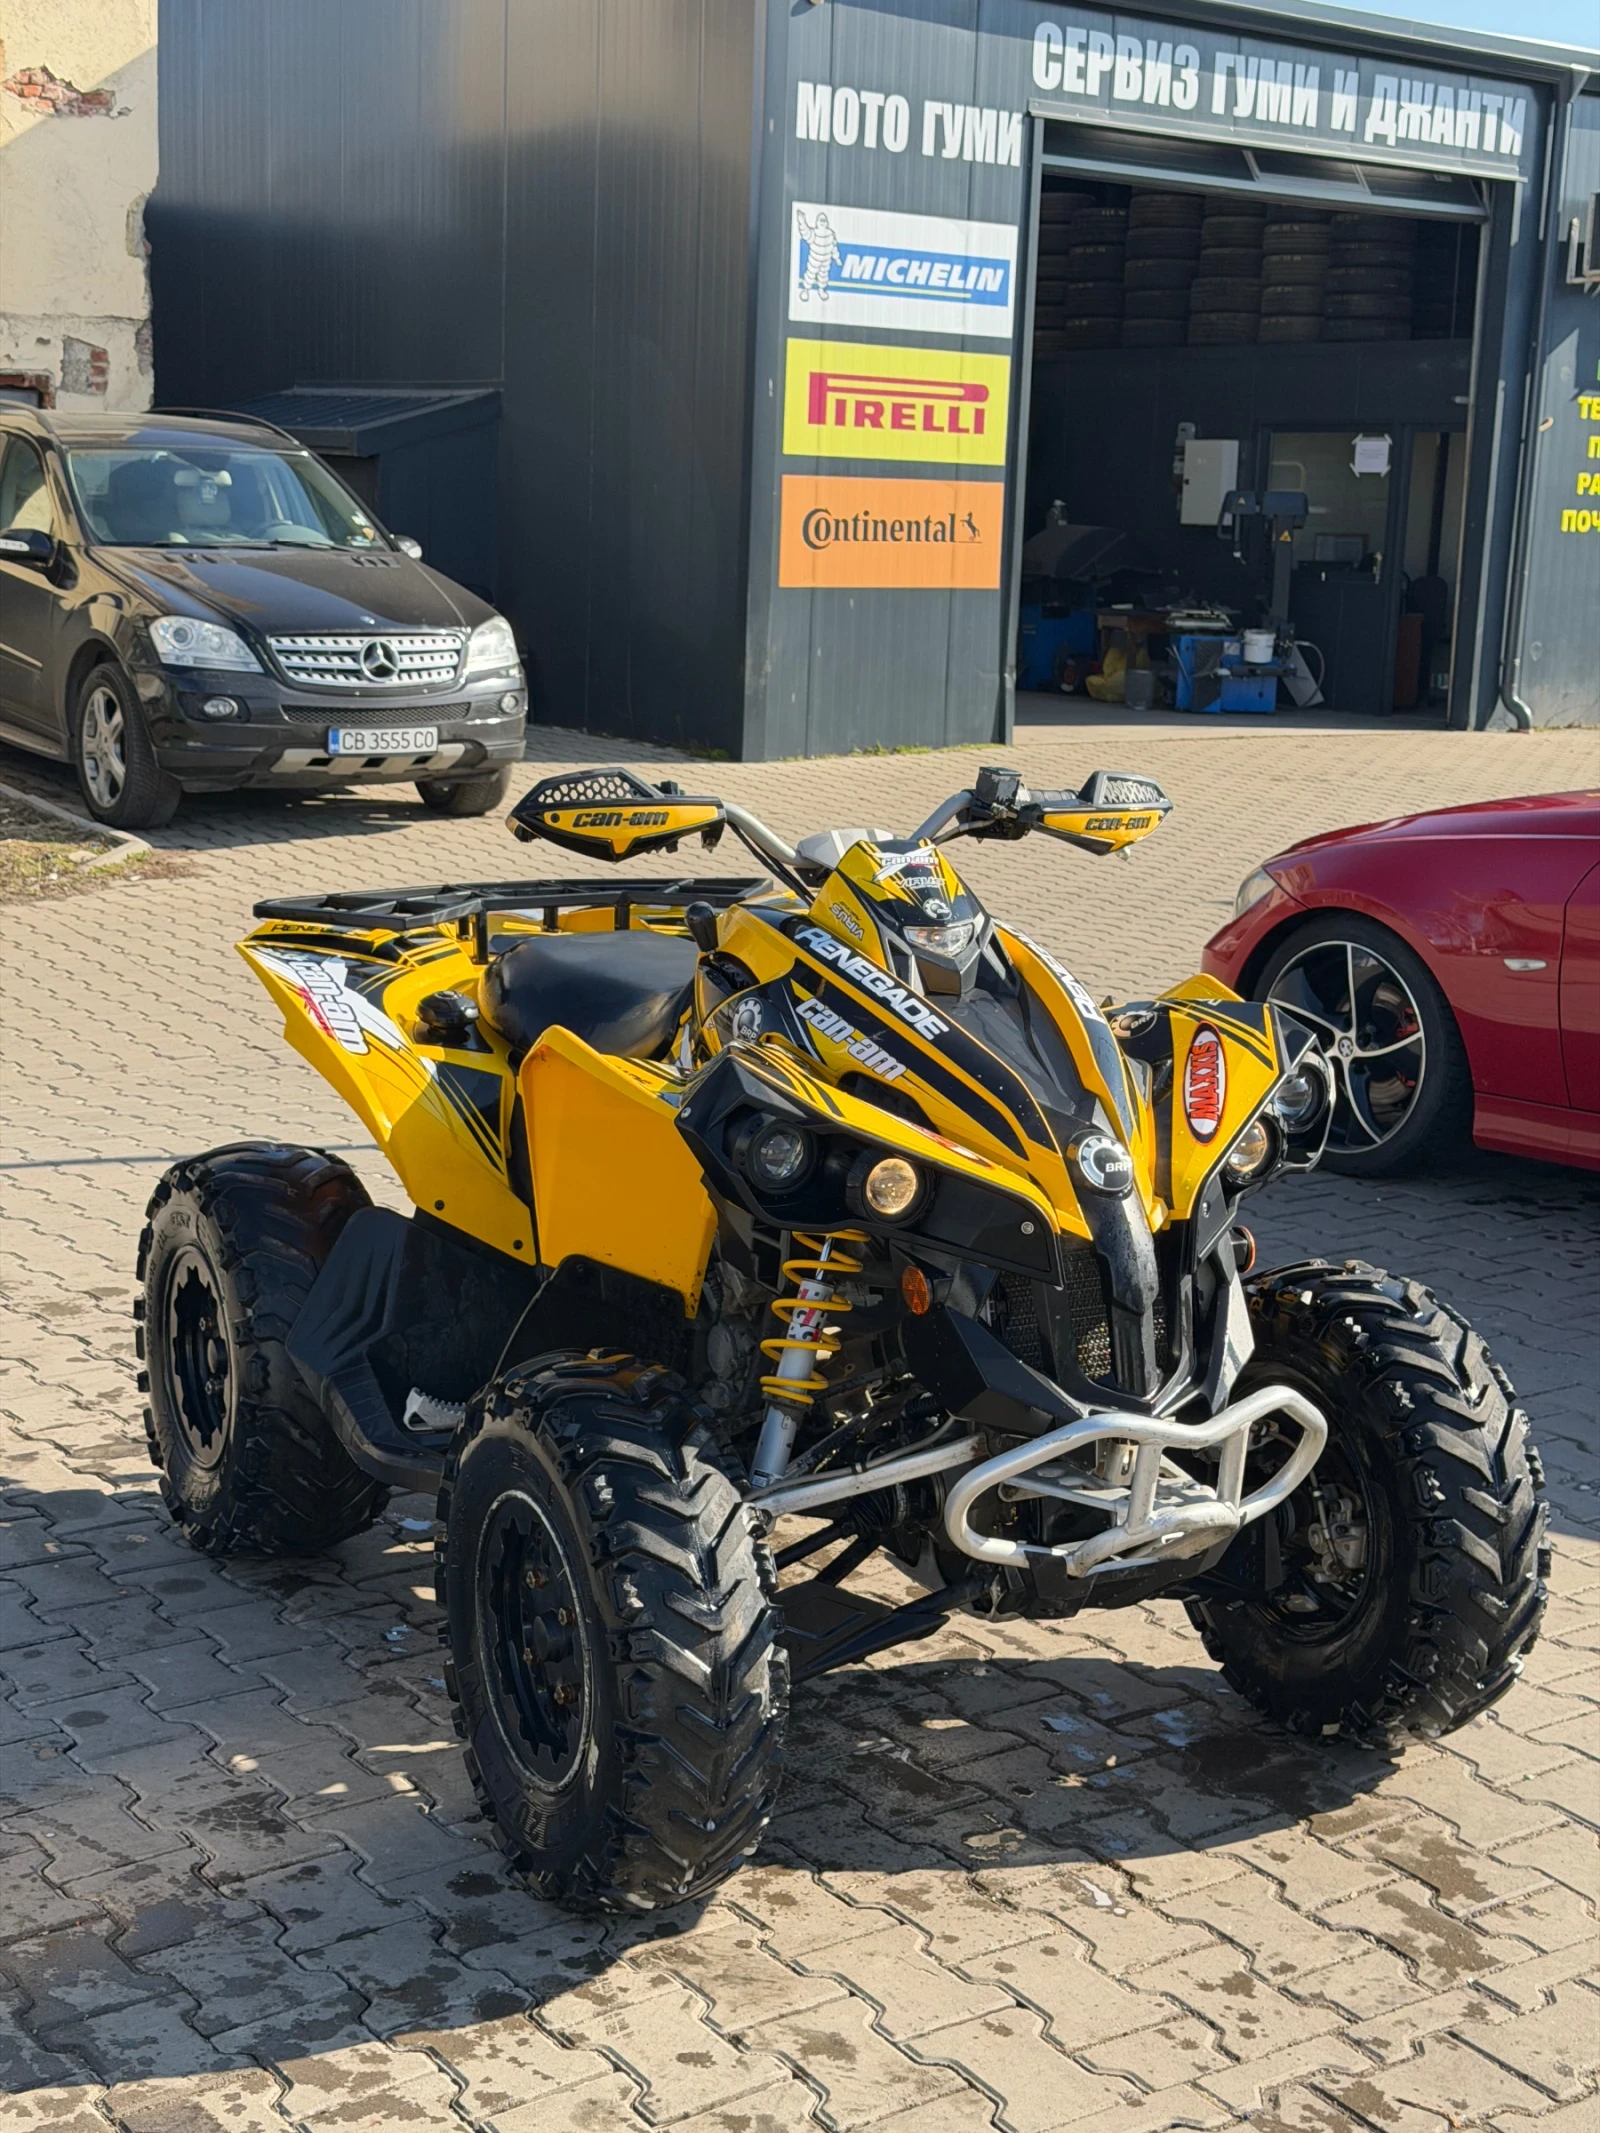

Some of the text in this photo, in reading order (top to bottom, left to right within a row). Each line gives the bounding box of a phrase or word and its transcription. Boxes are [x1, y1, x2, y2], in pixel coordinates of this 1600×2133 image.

[1032, 21, 1527, 156] СЕРВИЗ ГУМИ И ДЖАНТИ
[796, 80, 1023, 167] МОТО ГУМИ
[840, 253, 1005, 293] MICHELIN
[808, 371, 989, 435] PIRELLI
[802, 508, 956, 551] Continental
[368, 731, 411, 750] 3555
[572, 811, 670, 828] can-am
[1085, 816, 1151, 831] can-am
[829, 903, 865, 941] VIRUS
[795, 927, 950, 1041] RENEGADE
[288, 960, 371, 1056] can-am
[739, 1025, 757, 1041] BRP
[796, 997, 908, 1082] can-am
[1190, 1040, 1219, 1121] MAXXIS
[1105, 1161, 1134, 1173] BRP
